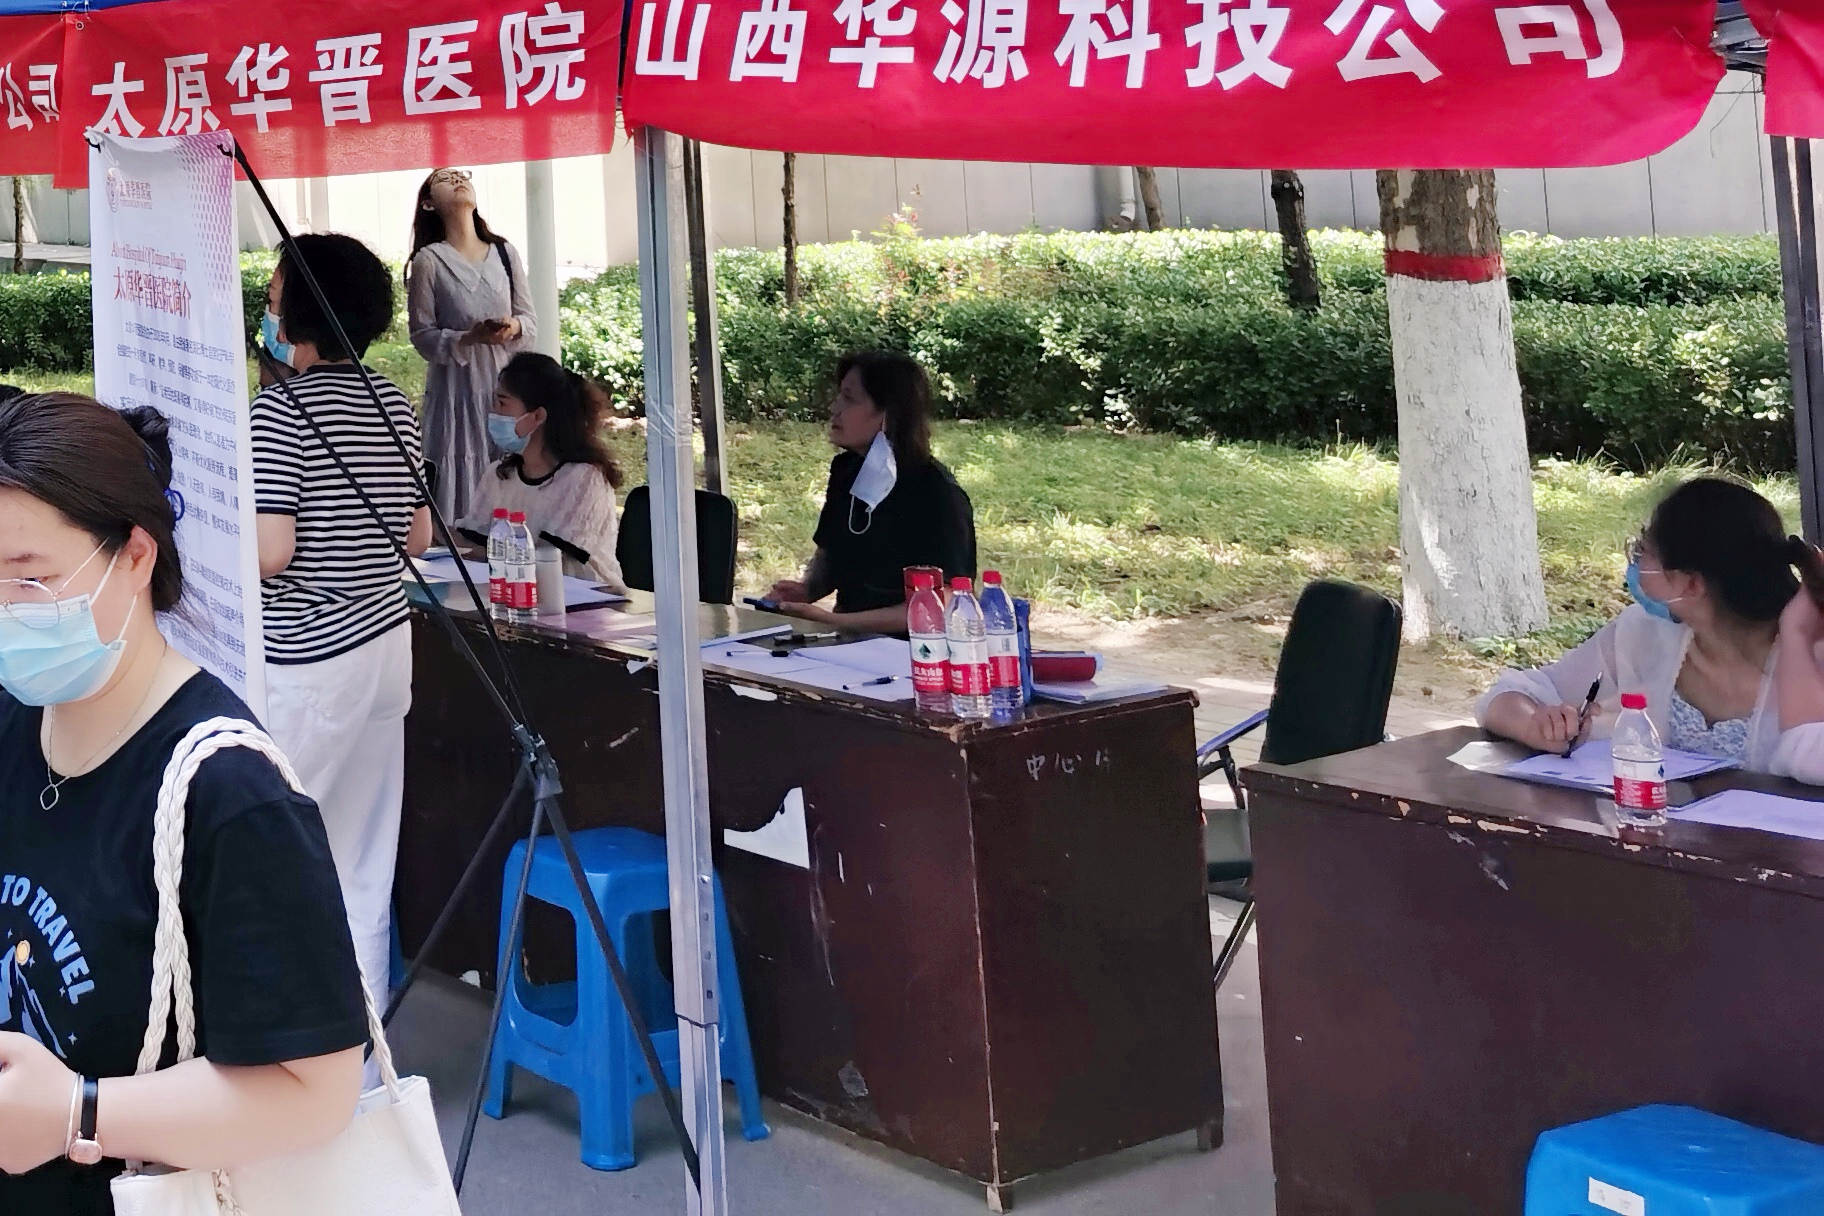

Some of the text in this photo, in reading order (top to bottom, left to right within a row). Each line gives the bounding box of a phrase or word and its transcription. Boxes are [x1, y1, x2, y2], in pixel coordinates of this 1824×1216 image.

[91, 3, 587, 138] 太原华晋医院
[113, 266, 191, 320] 太原华晋医院简介
[28, 886, 95, 1005] TRAVEL
